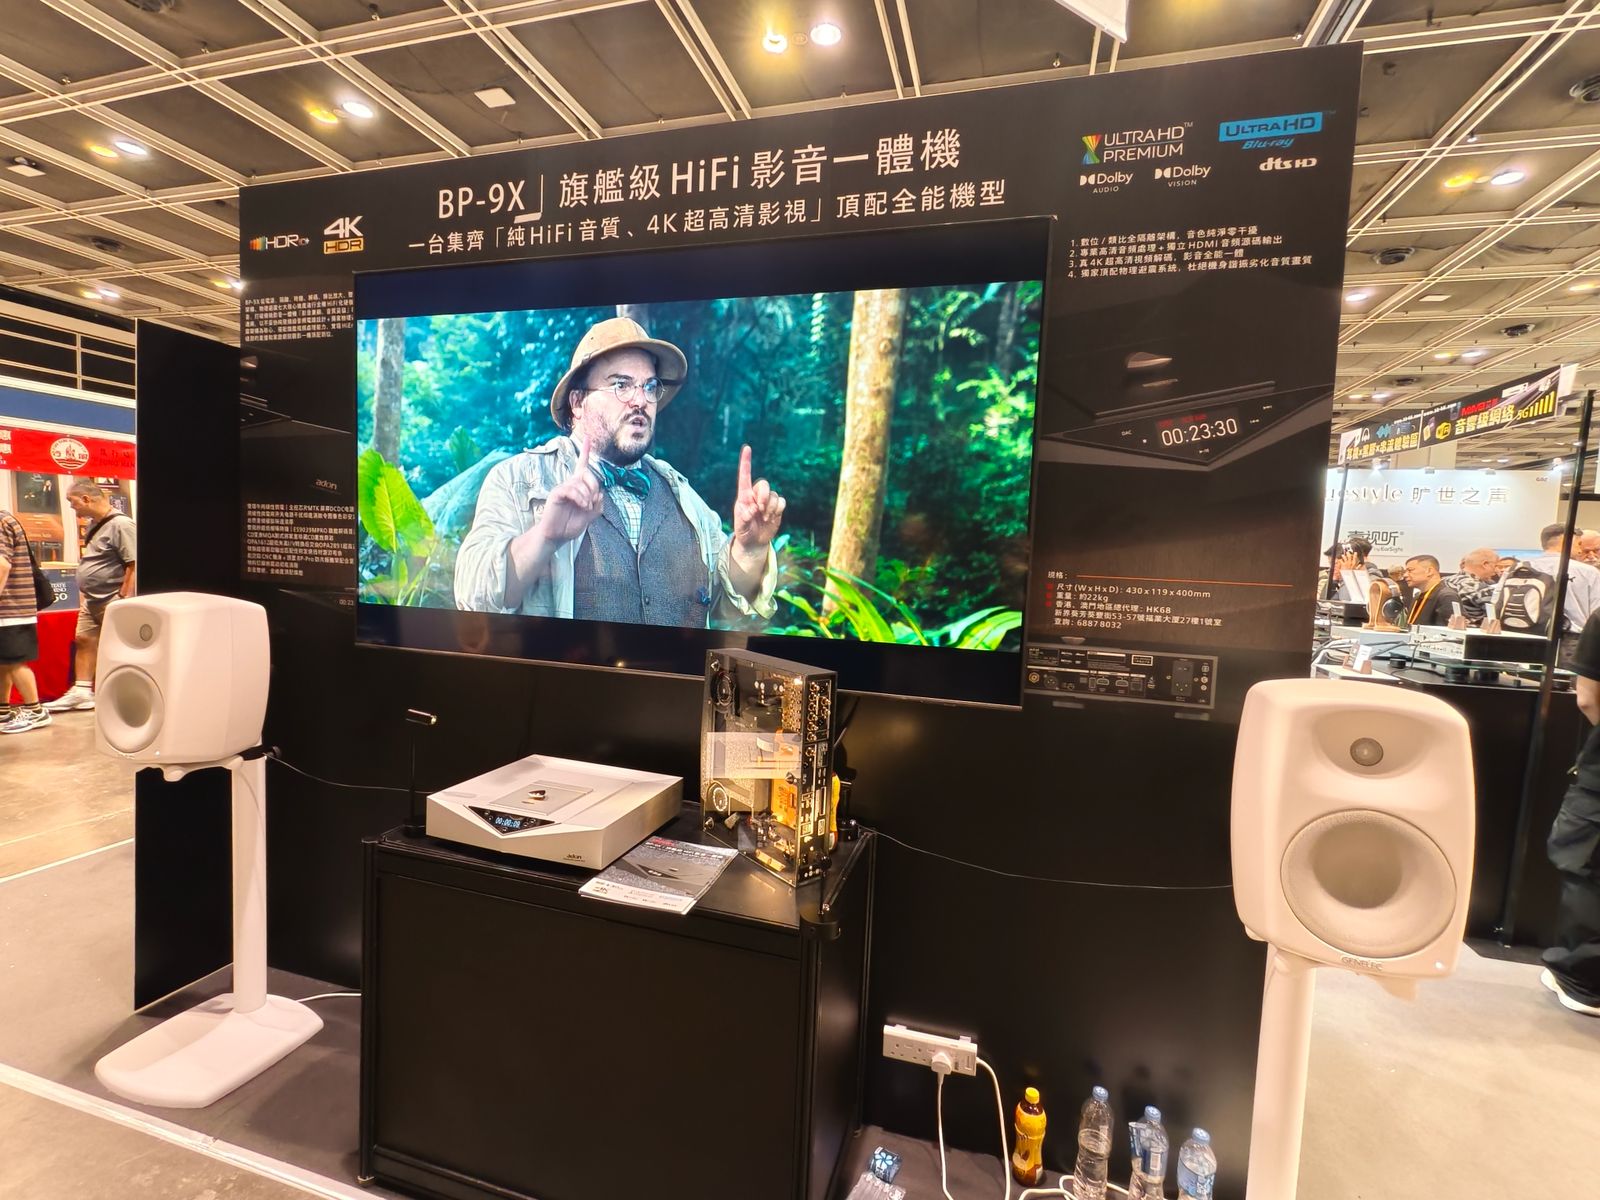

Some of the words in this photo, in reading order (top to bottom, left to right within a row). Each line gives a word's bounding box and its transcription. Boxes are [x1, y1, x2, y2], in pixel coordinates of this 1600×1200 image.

[1242, 138, 1295, 150] Blu-ray
[1104, 142, 1184, 163] PREMIUM
[1172, 164, 1212, 180] Dolby
[1259, 157, 1293, 171] dts
[438, 180, 526, 220] BP-9X
[558, 163, 662, 209] 旗艦級
[670, 156, 739, 194] HiFi
[750, 128, 961, 190] 影音一體機
[1097, 171, 1134, 187] Dolby
[1168, 179, 1198, 188] VISION
[530, 222, 573, 245] HiFi
[646, 212, 677, 234] 4K
[836, 179, 1006, 218] 頂配全能機型
[323, 216, 364, 239] 4K
[325, 240, 362, 252] HDR
[1188, 240, 1218, 249] HDMI
[1090, 258, 1103, 266] 4K
[1161, 418, 1238, 446] 00:23:30
[1341, 956, 1384, 972] GENELEC
